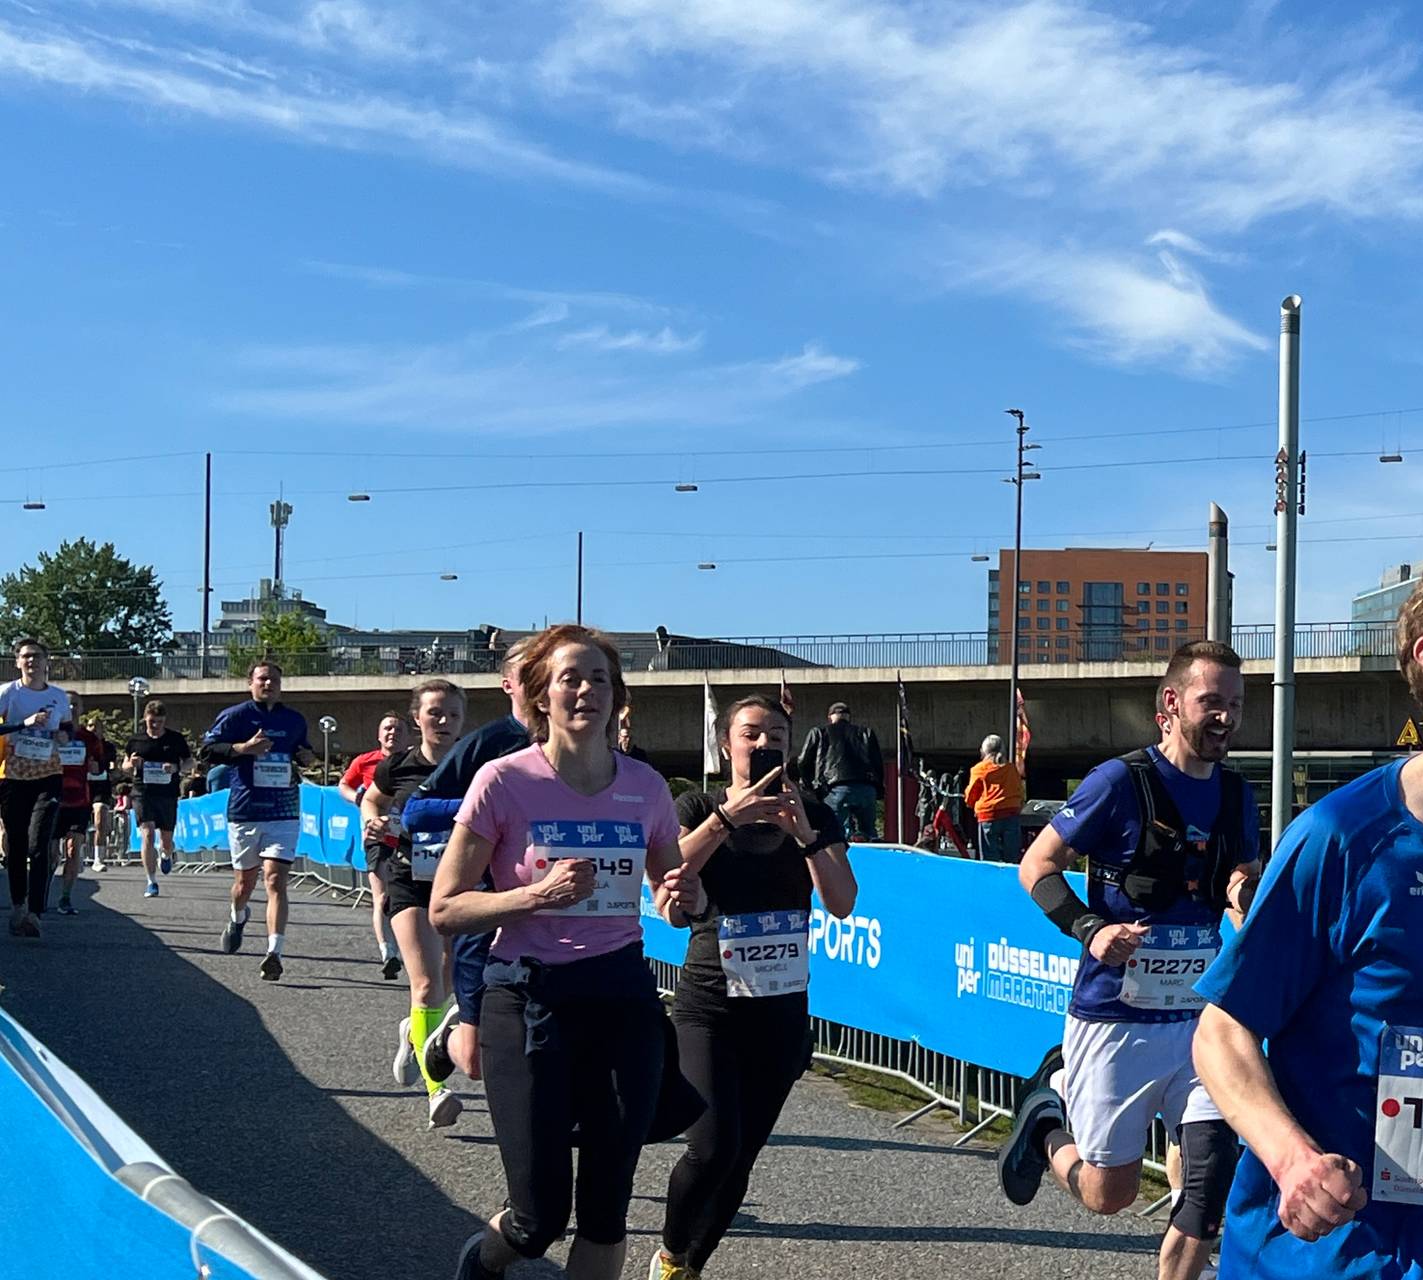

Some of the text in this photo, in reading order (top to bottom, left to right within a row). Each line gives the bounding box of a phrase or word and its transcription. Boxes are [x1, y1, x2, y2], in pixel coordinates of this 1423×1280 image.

[538, 821, 631, 834] uni uni uni
[543, 832, 639, 845] per per per
[734, 943, 799, 962] 12279
[955, 936, 975, 969] uni
[987, 936, 1081, 987] DÜSSELDOR
[1140, 958, 1206, 974] 12273
[957, 967, 982, 999] per
[1159, 978, 1185, 987] MARC
[986, 970, 1073, 1016] MARATHO
